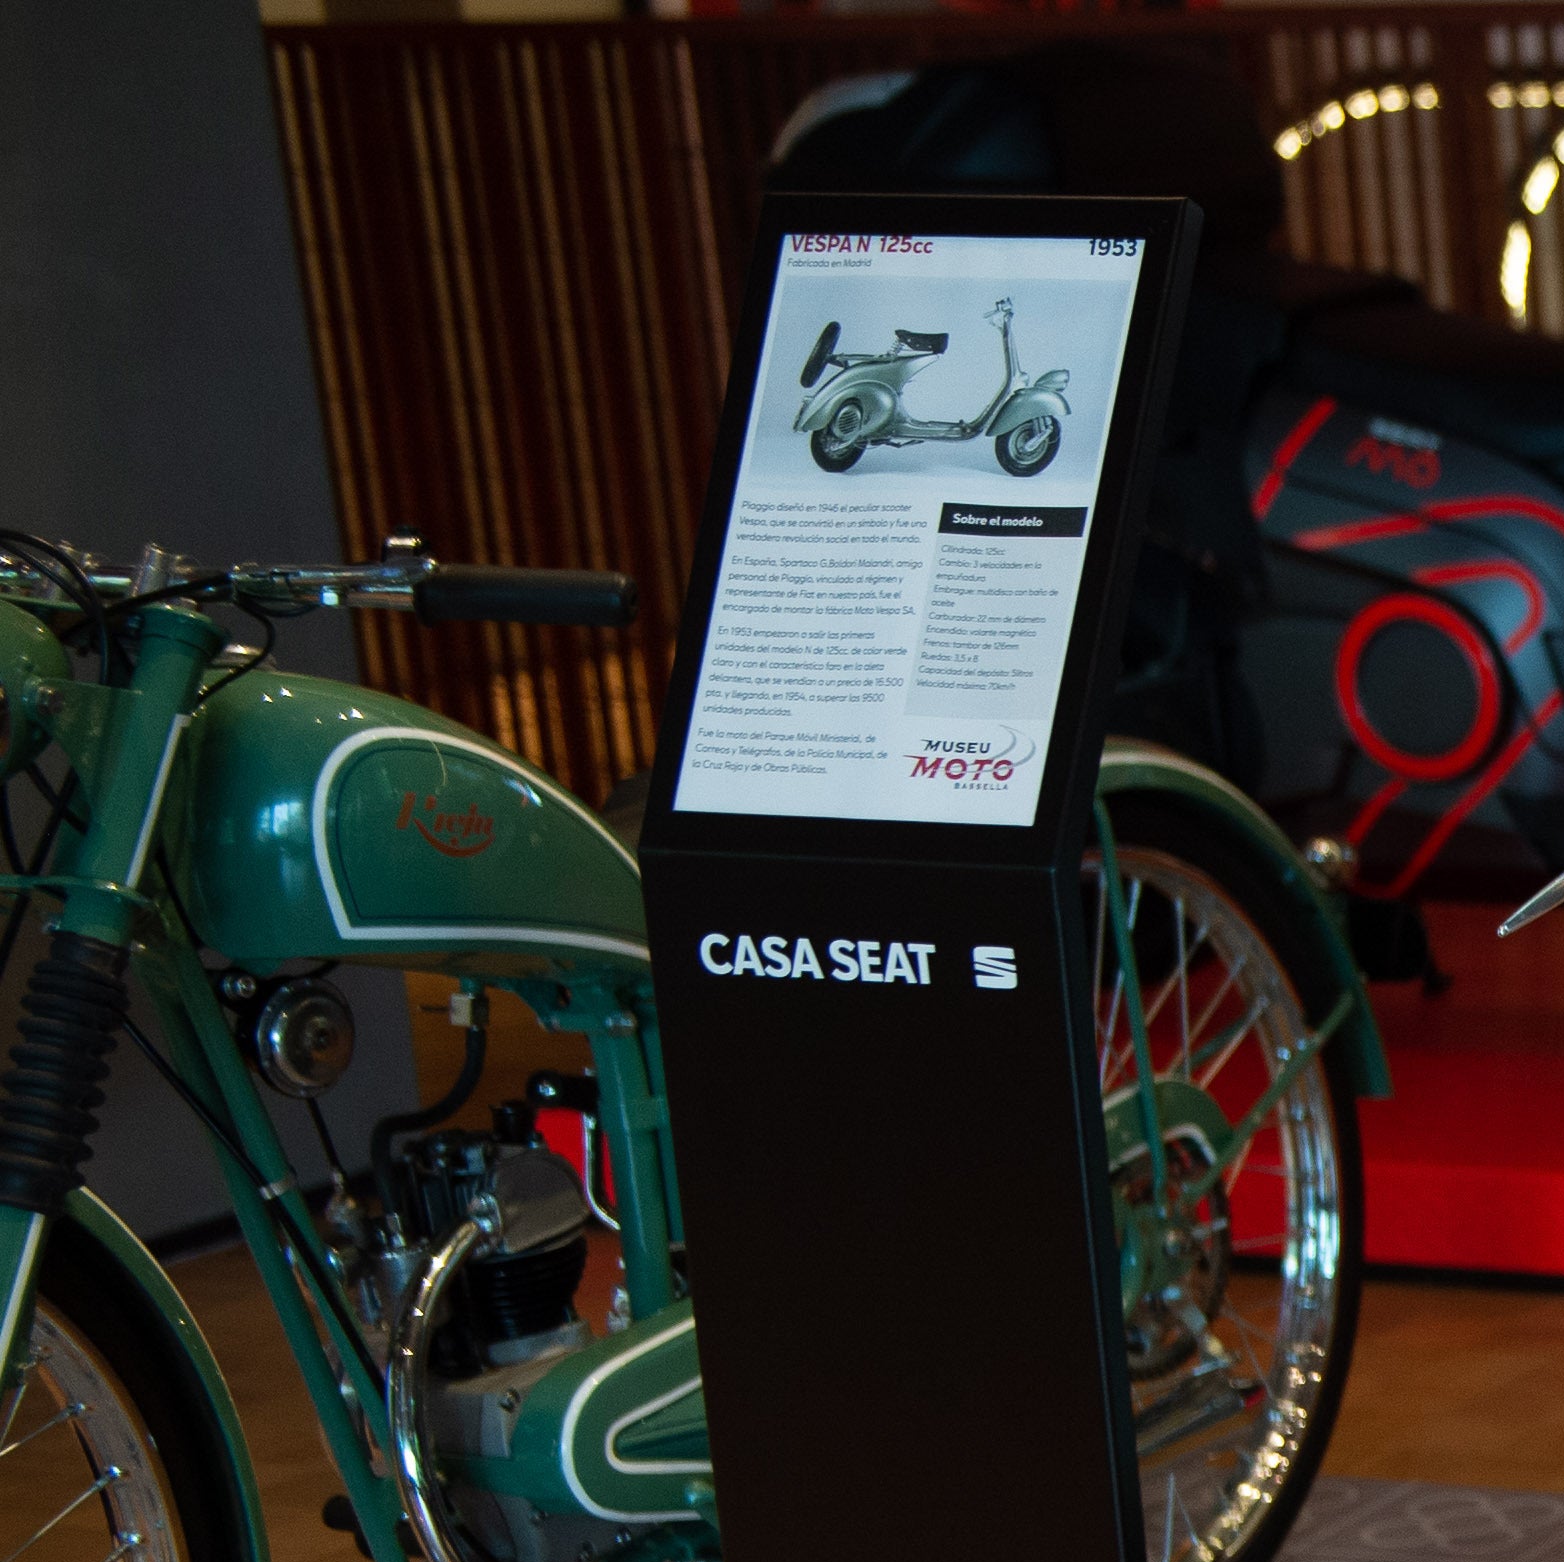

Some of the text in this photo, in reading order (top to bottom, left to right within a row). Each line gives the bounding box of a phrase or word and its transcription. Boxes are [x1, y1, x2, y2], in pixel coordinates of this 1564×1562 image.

[792, 235, 933, 253] VESPA N 125cc
[1090, 239, 1137, 256] 1953
[788, 258, 829, 268] Fabricada
[843, 258, 872, 267] Madrid
[953, 513, 1044, 527] Sobre el modelo
[920, 739, 991, 754] MUSEU
[904, 755, 1014, 781] MOTO
[699, 933, 936, 985] CASA SEAT
